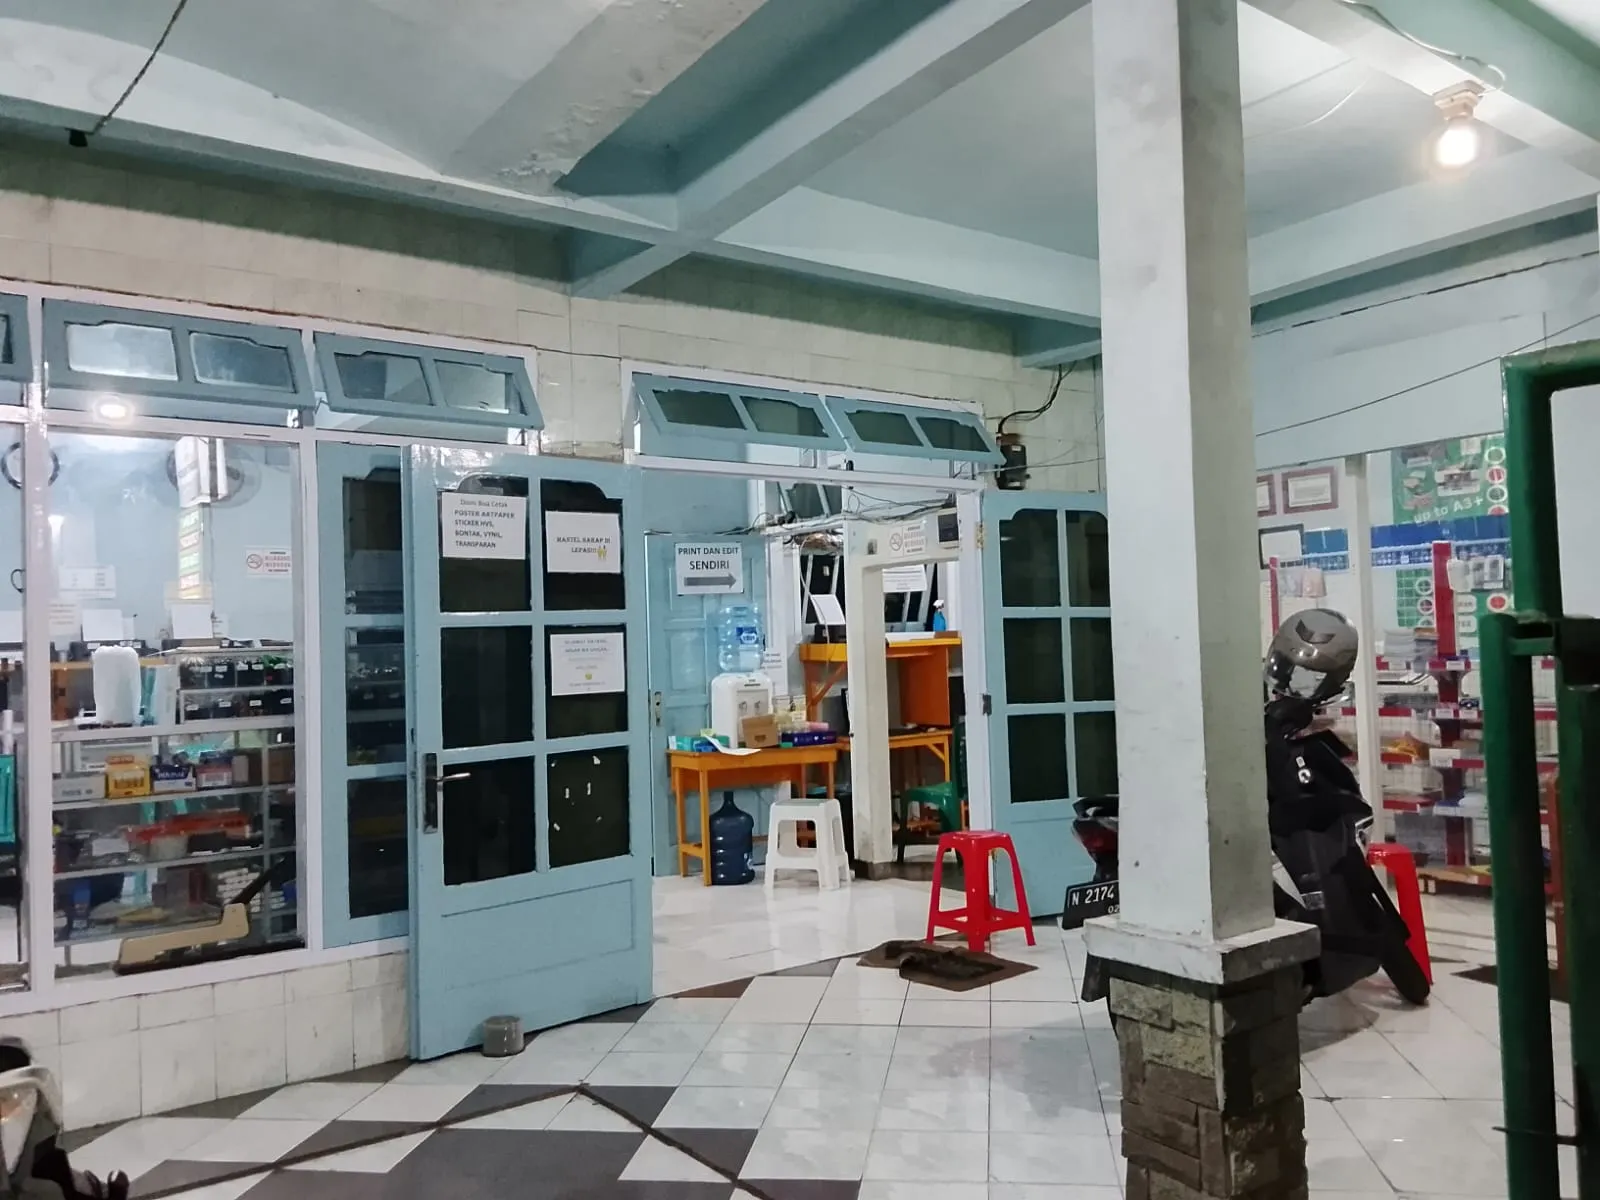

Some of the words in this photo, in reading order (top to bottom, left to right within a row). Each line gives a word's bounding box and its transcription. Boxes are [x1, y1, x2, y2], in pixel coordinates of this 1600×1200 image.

[454, 509, 480, 517] POSTER
[1413, 510, 1432, 527] up
[1433, 505, 1449, 518] to
[1452, 496, 1484, 513] A3+
[455, 540, 497, 548] TRANSPARAN
[678, 547, 701, 555] PRINT
[703, 547, 720, 555] DAN
[722, 547, 738, 555] EDIT
[689, 560, 730, 570] SENDIRI
[1072, 892, 1079, 906] N
[1085, 886, 1114, 904] 2174
